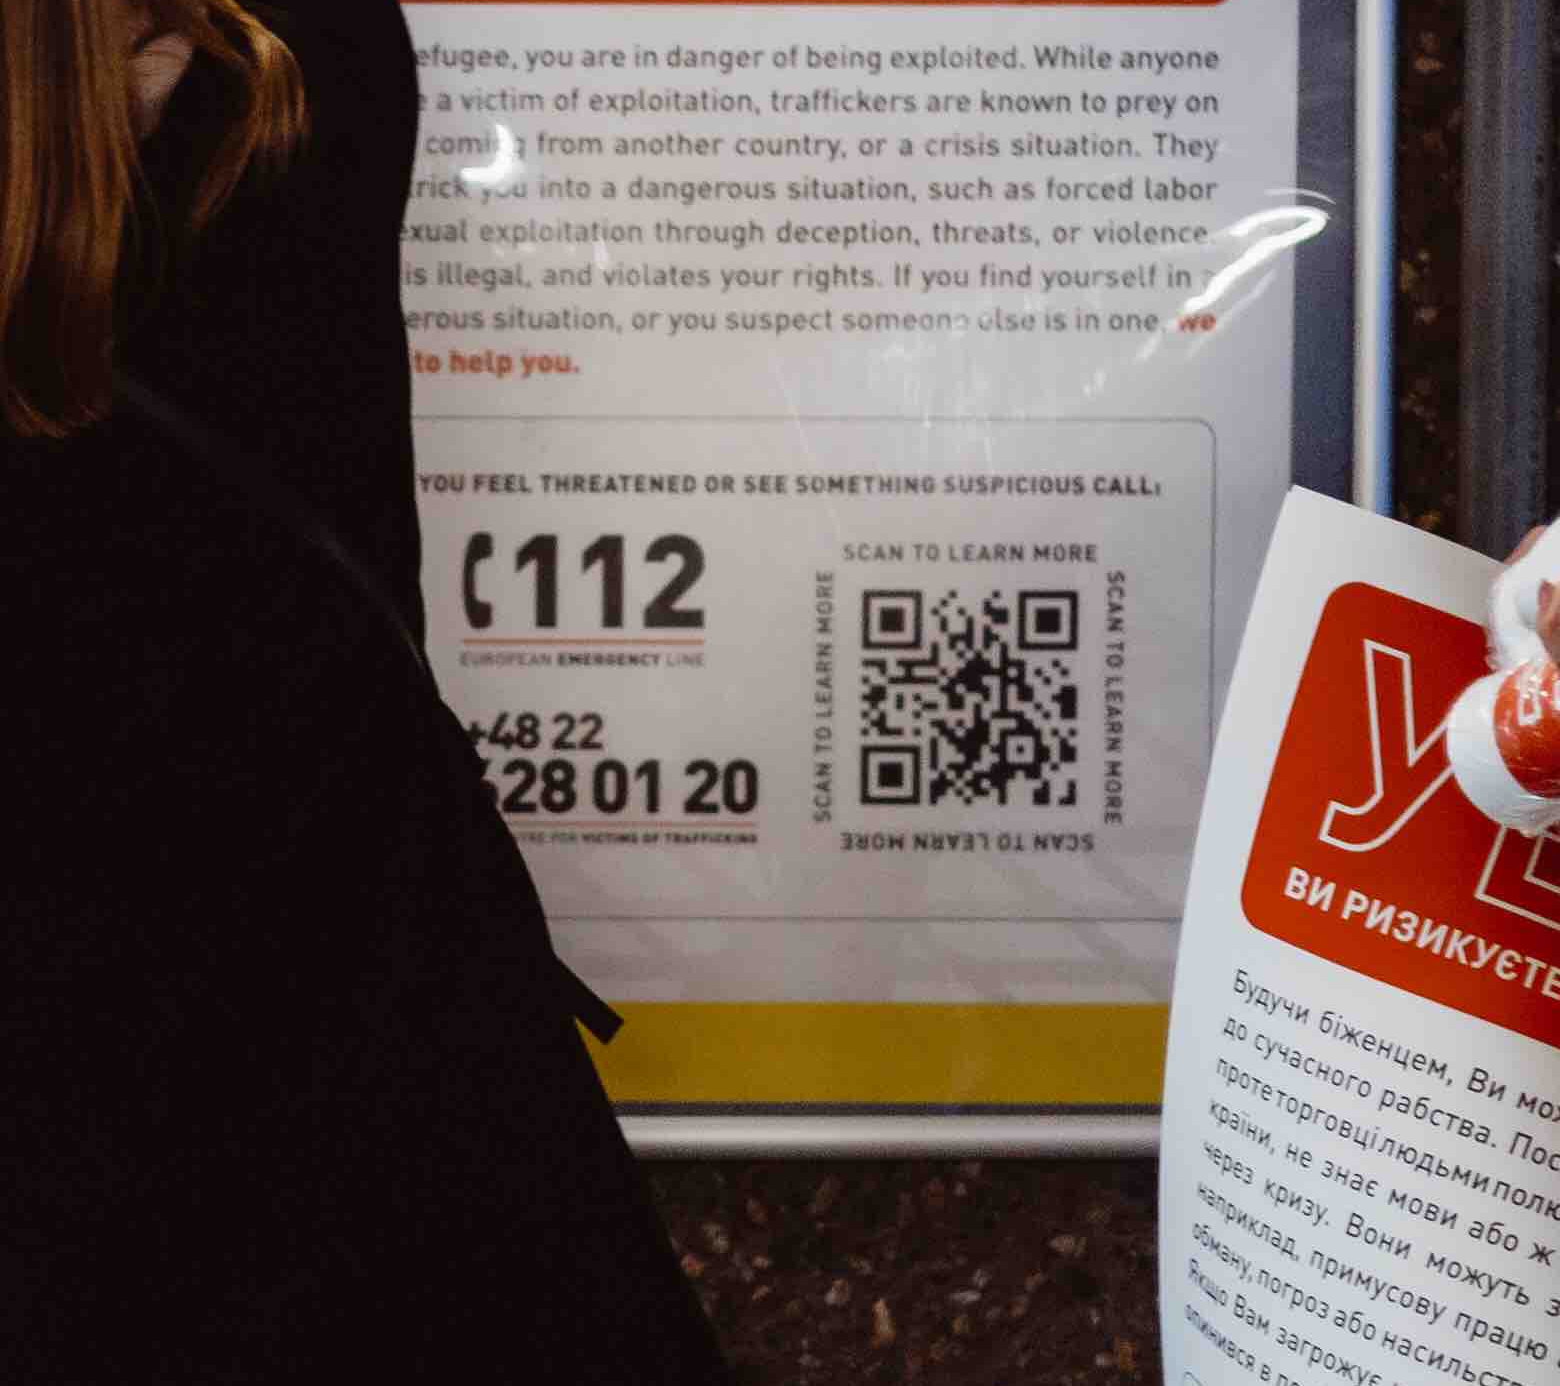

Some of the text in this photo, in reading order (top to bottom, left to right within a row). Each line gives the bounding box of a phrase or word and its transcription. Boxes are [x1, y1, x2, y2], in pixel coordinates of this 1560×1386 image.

[415, 43, 1220, 75] efugee, you are in danger of being exploited. While anyone
[436, 86, 1220, 119] a victim of exploitation, traffickers are known to prey on
[537, 131, 1220, 162] from another country, or a crisis situation. They
[414, 348, 579, 378] to help you.
[419, 474, 464, 495] YOU
[473, 474, 531, 495] FEEL
[541, 474, 697, 495] THREATENED
[704, 474, 736, 495] OR
[744, 474, 786, 495] SEE
[794, 474, 936, 495] SOMETHING
[943, 475, 1085, 496] SUSPICIOUS
[843, 544, 1098, 562] SCAN TO LEARN MORE
[514, 533, 706, 629] 112
[813, 571, 834, 823] SCAN TO LEARN MORE
[1104, 570, 1126, 825] SCAN TO LEARN MORE
[551, 711, 605, 751] 22
[482, 759, 759, 814] 28 01 20
[840, 834, 1095, 852] SCAN TO LEARN MORE
[1283, 866, 1337, 912] ВИ
[1232, 968, 1311, 1025] Будучи
[1318, 1011, 1453, 1088] біженцем,
[1467, 1066, 1507, 1102] Ви
[1222, 1016, 1248, 1042] до
[1254, 1030, 1373, 1099] сучасного
[1378, 1088, 1497, 1149] рабства.
[1284, 1142, 1313, 1170] не
[1320, 1159, 1380, 1198] знає
[1387, 1188, 1459, 1231] мови
[1468, 1219, 1520, 1253] або
[1528, 1241, 1557, 1267] ж
[1344, 1211, 1413, 1260] Вони
[1426, 1252, 1531, 1307] можуть
